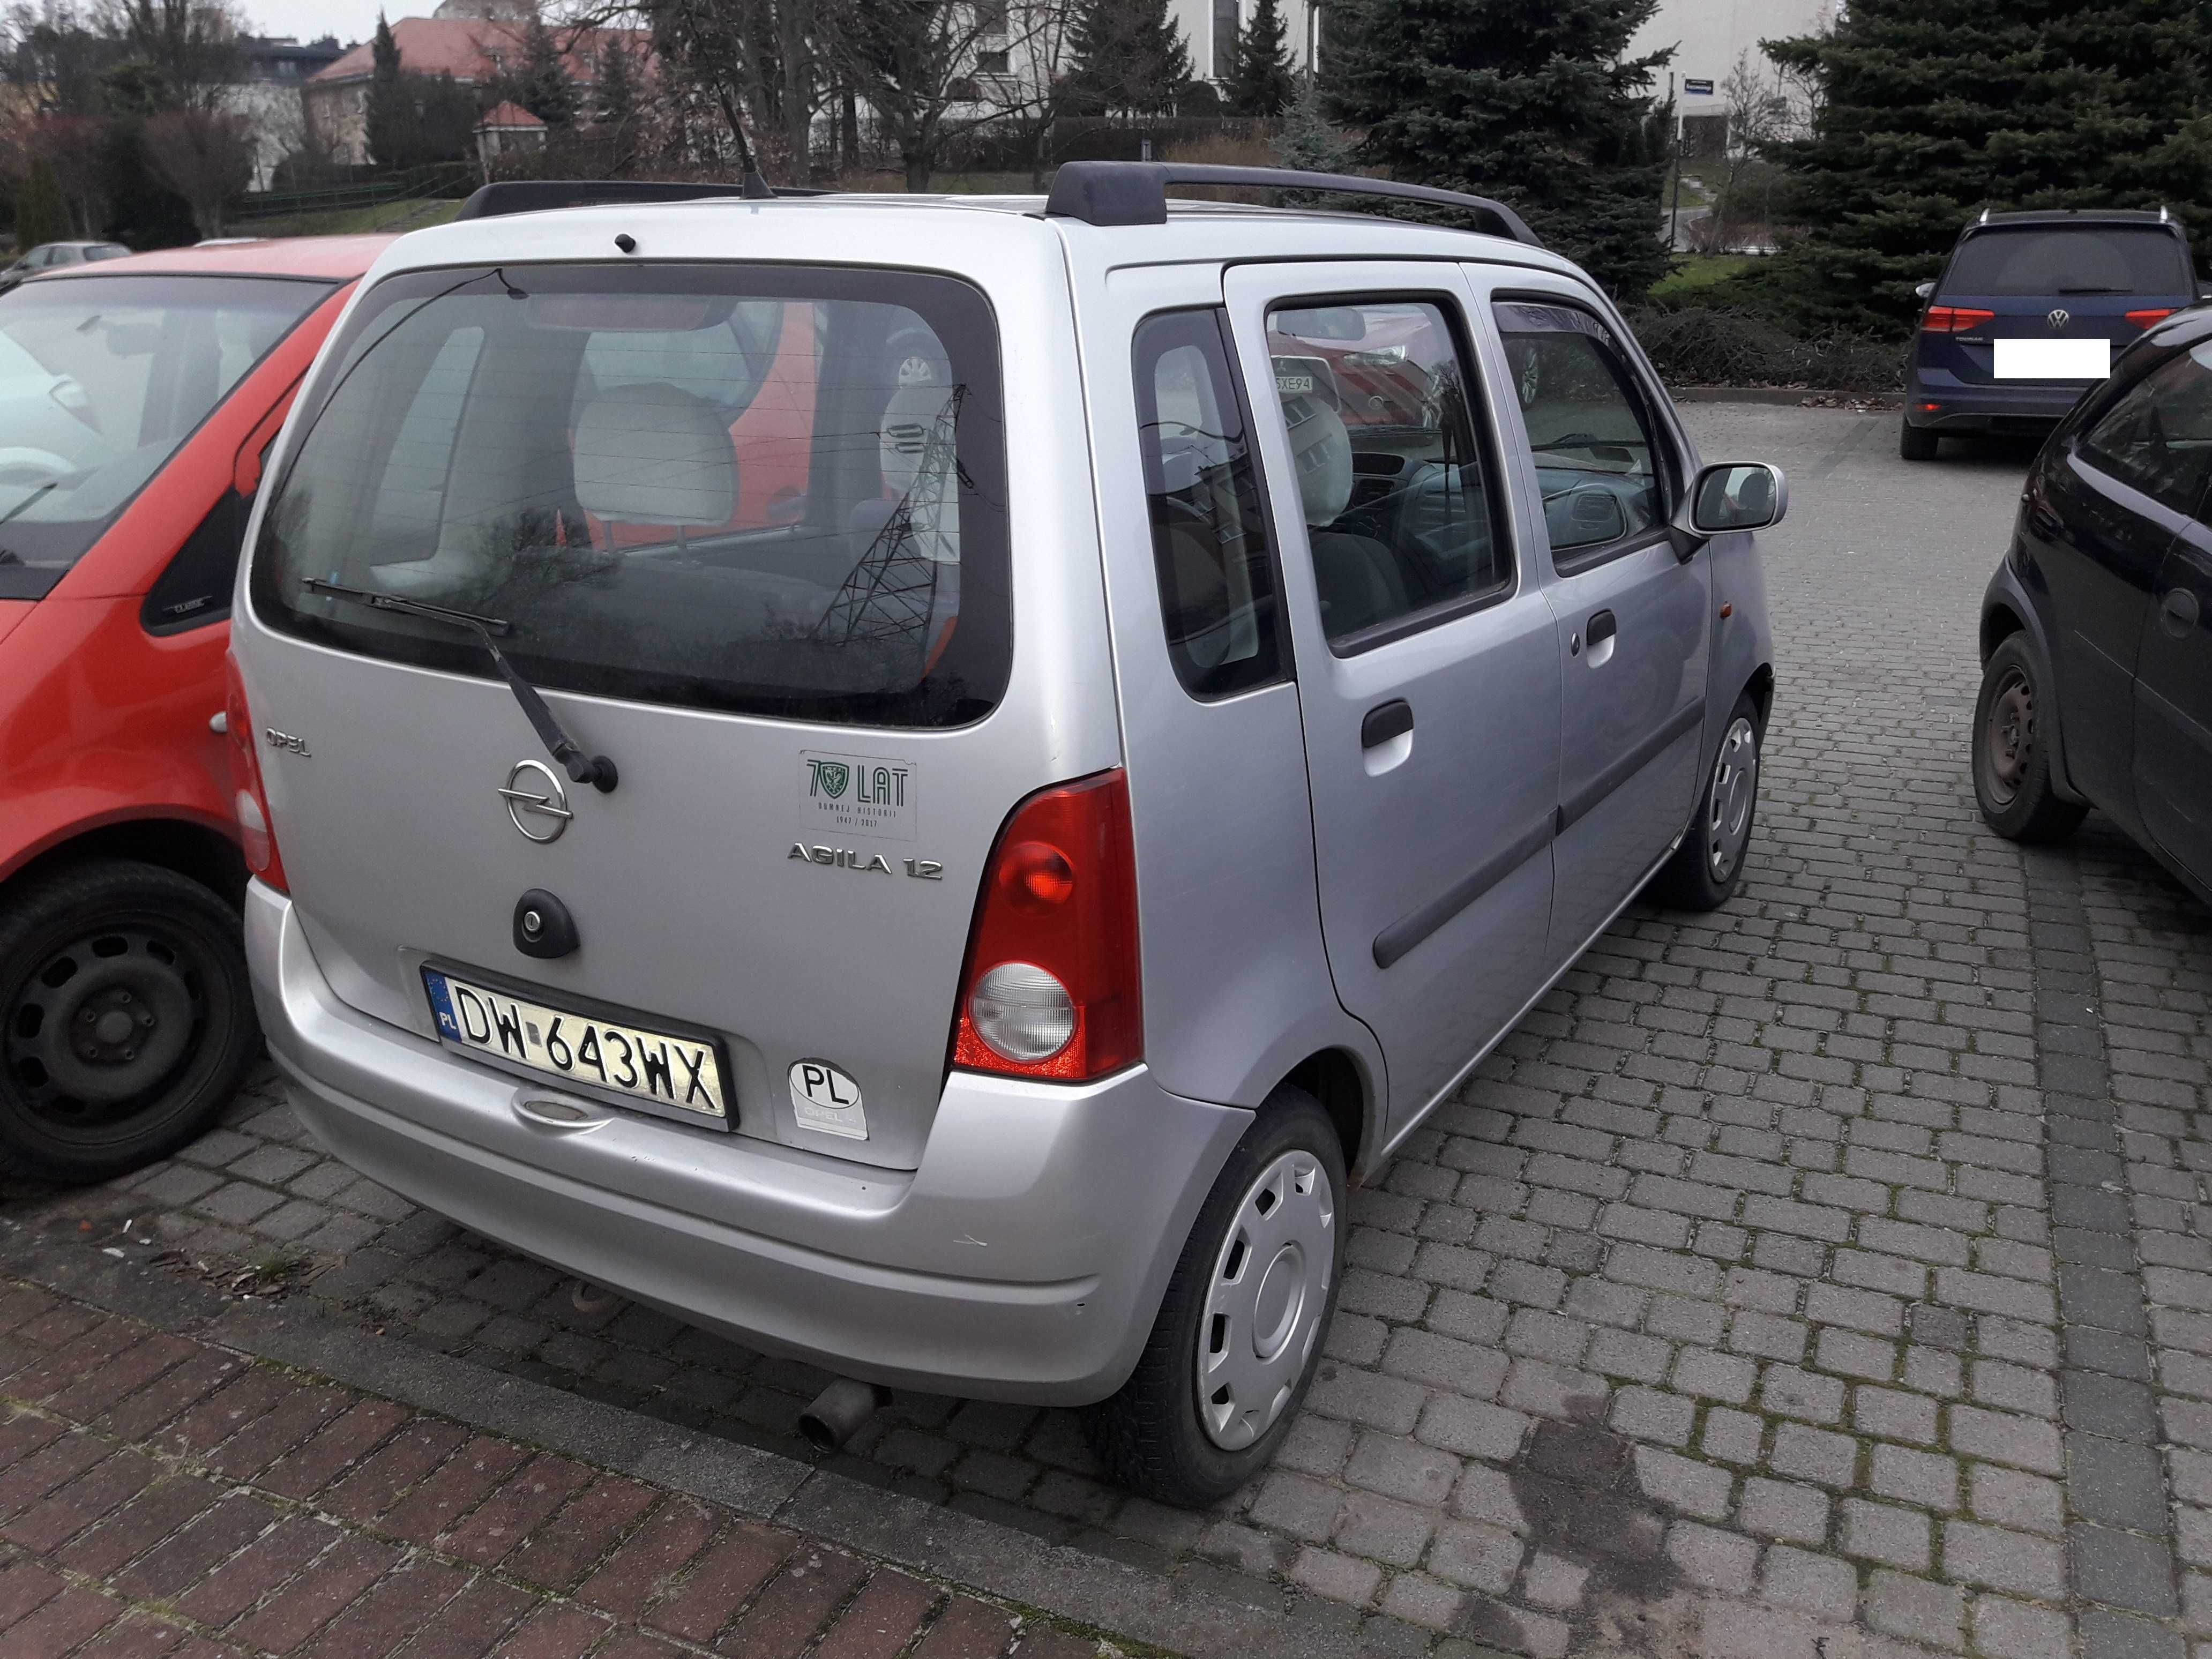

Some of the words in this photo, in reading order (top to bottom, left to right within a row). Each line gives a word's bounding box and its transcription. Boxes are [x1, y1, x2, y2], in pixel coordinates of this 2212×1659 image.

[267, 727, 311, 758] OPEL
[857, 765, 908, 806] LAT
[836, 816, 852, 825] 1947
[861, 818, 877, 827] 2017
[787, 842, 892, 875] AGILA
[440, 1012, 458, 1030] PL
[454, 984, 529, 1059] DW
[546, 1015, 717, 1109] 643WX
[802, 1064, 850, 1105] PL
